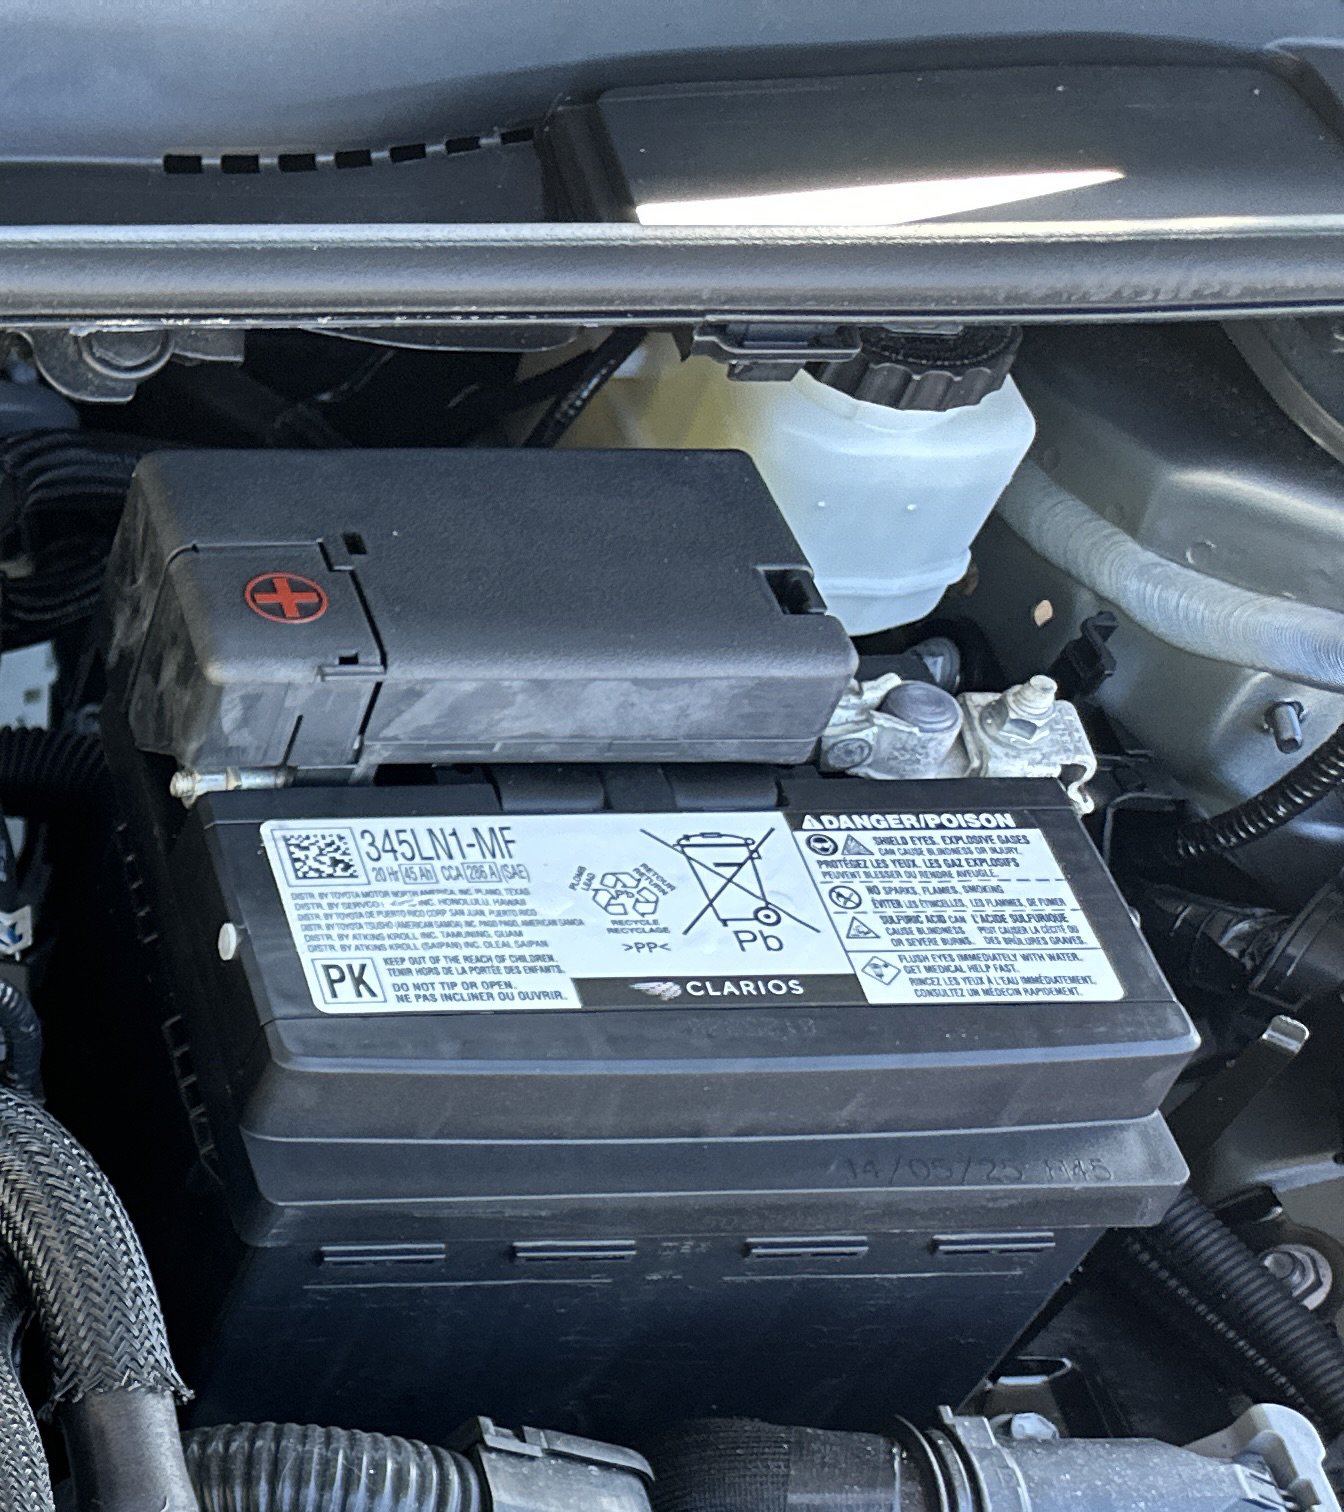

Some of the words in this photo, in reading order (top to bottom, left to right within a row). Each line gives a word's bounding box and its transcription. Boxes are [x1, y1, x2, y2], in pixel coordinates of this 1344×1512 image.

[819, 812, 1017, 830] DANGER/POISON
[357, 826, 522, 862] 345LN1-MF
[871, 835, 910, 846] SHIELD
[939, 834, 997, 845] EXPLOSIVE
[995, 834, 1030, 844] GASES
[814, 857, 870, 870] PROTÉGEZ
[868, 859, 890, 869] LES
[921, 858, 943, 868] LES
[941, 857, 964, 868] GAZ
[964, 857, 1021, 867] EXPLOSIFS
[370, 866, 388, 882] 20
[385, 866, 401, 882] Hr
[401, 865, 419, 881] 45
[416, 865, 434, 881] Ah
[439, 864, 465, 881] CCA
[465, 864, 489, 880] 286
[485, 864, 498, 880] A
[498, 863, 532, 883] (SAE)
[820, 870, 864, 880] PEUVENT
[862, 869, 904, 880] BLESSER
[902, 869, 919, 879] OU
[917, 869, 955, 879] RENDRE
[953, 868, 1000, 878] AVEUGLE.
[580, 872, 597, 892] LEAD
[631, 867, 669, 896] RETURN
[864, 886, 882, 895] NO
[960, 884, 1005, 894] SMOKING
[609, 918, 660, 926] RECYCLE
[878, 914, 925, 925] SULFURIC
[922, 914, 948, 924] ACID
[946, 913, 967, 924] CAN
[969, 913, 1009, 924] L'ACIDE
[1007, 912, 1070, 923] SULFURIQUE
[335, 932, 350, 941] BY
[349, 932, 385, 941] ATKINS
[385, 931, 419, 940] KROLL
[493, 930, 525, 939] GUAM
[605, 926, 671, 934] RECYCLAGE
[883, 926, 917, 936] CAUSE
[914, 925, 966, 935] BLINDNESS
[621, 941, 672, 952] >PP<
[732, 929, 786, 952] Pb
[888, 937, 905, 947] OR
[904, 937, 940, 947] SEVERE
[382, 956, 407, 965] KEEP
[407, 956, 428, 965] OUT
[428, 955, 443, 965] OF
[442, 955, 462, 965] THE
[461, 955, 494, 964] REACH
[493, 954, 508, 964] OF
[897, 954, 931, 964] FLUSH
[929, 953, 957, 963] EYES
[955, 952, 1019, 963] IMMEDIATELY
[1018, 952, 1047, 962] WITH
[385, 966, 414, 976] TENIR
[413, 966, 441, 976] HORS
[440, 965, 455, 976] DE
[453, 965, 468, 975] LA
[501, 964, 522, 975] DES
[901, 964, 924, 974] GET
[922, 964, 966, 974] MEDICAL
[965, 963, 993, 973] HELP
[322, 963, 381, 999] PK
[391, 981, 410, 992] DO
[411, 981, 438, 992] NOT
[437, 981, 459, 991] TIP
[459, 980, 480, 991] OR
[907, 976, 942, 987] RINCEZ
[941, 976, 961, 986] LES
[960, 976, 986, 986] YEUX
[992, 975, 1020, 985] L'EAU
[683, 979, 806, 997] CLARIOS
[912, 987, 966, 997] CONSULTEZ
[965, 987, 981, 997] UN
[394, 992, 412, 1003] NE
[413, 992, 438, 1003] PAS
[438, 991, 496, 1002] INCLINER
[496, 990, 516, 1002] OU
